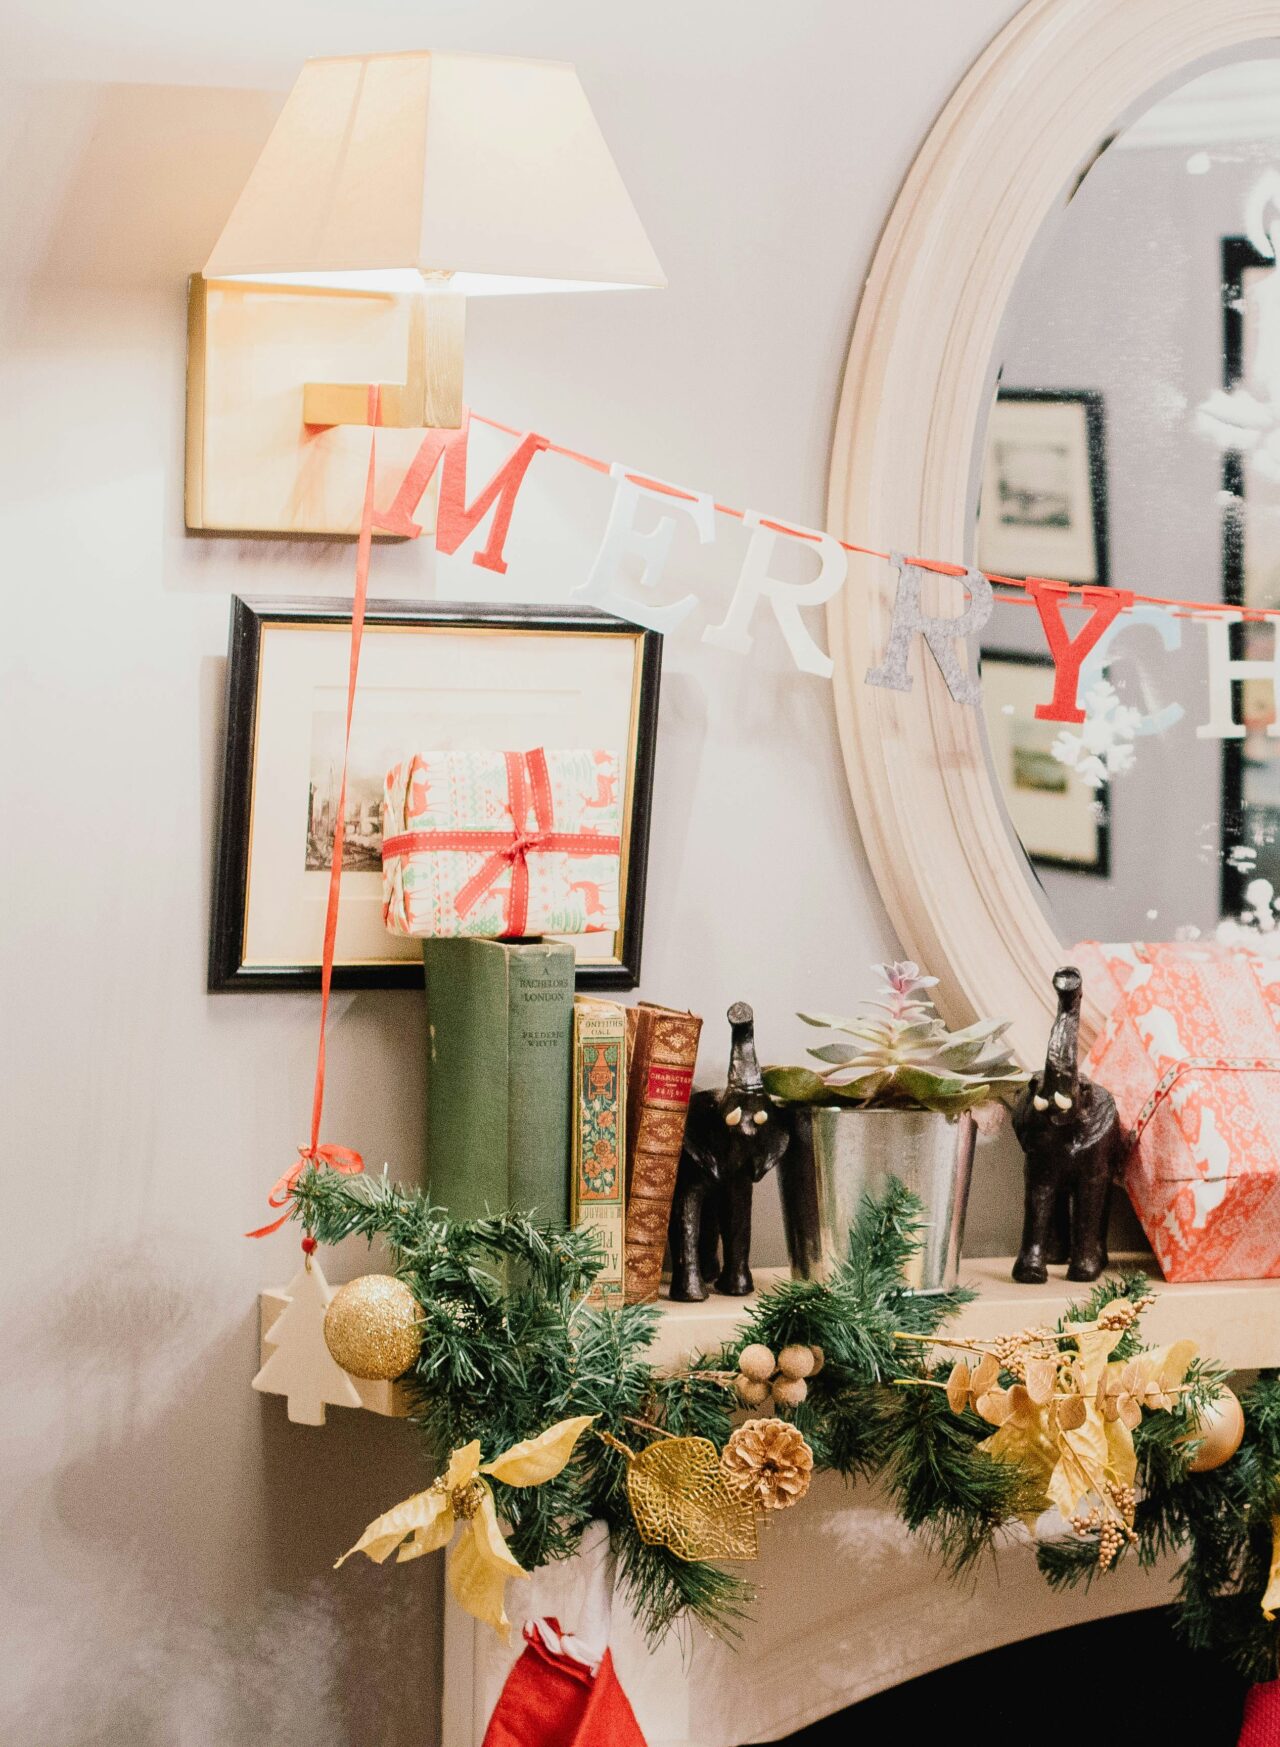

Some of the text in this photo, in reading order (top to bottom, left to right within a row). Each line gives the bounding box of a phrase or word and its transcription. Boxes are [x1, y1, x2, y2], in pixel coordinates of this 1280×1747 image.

[368, 408, 1135, 724] MERRY
[524, 992, 564, 1002] LONDON
[527, 1039, 558, 1047] WHYTE
